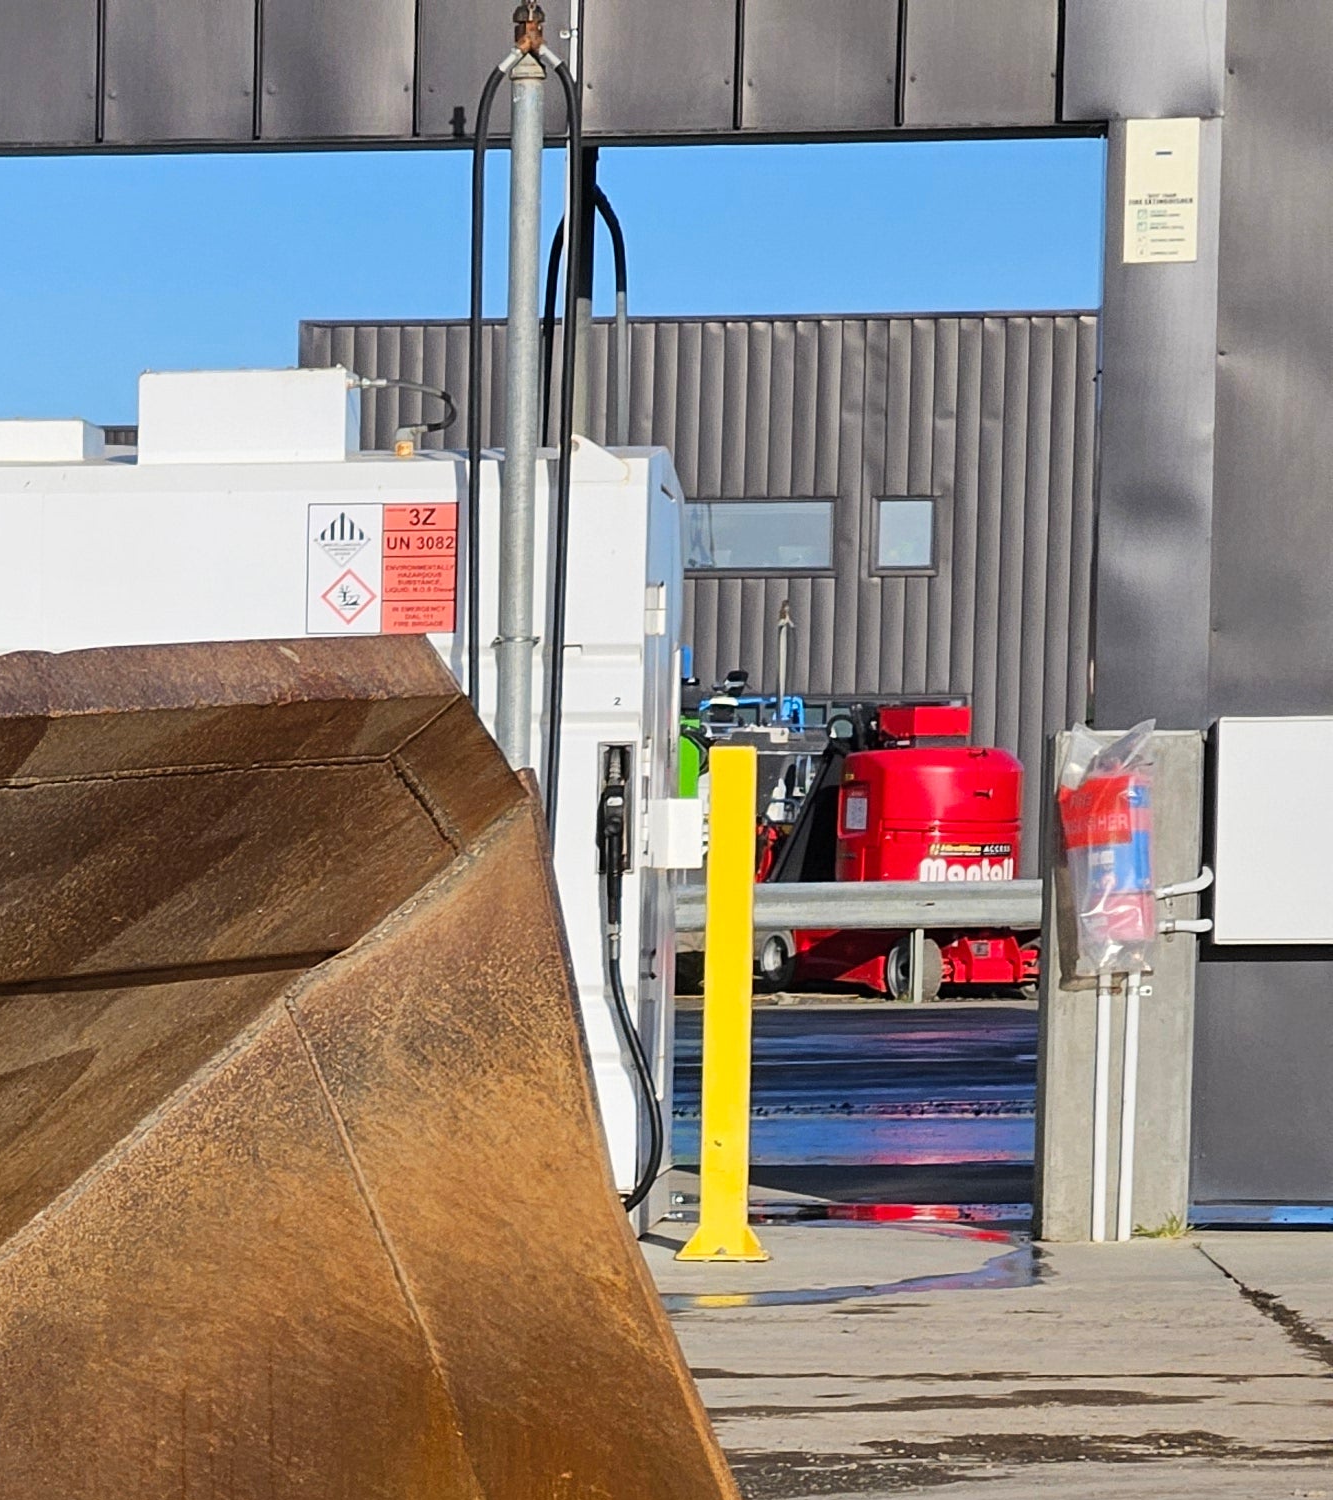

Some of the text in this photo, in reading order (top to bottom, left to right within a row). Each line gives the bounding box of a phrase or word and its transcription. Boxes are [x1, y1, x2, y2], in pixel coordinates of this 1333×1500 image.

[409, 507, 437, 526] 3Z
[386, 535, 455, 550] UN 3082
[614, 697, 622, 706] 2
[919, 857, 1014, 882] Mantall
